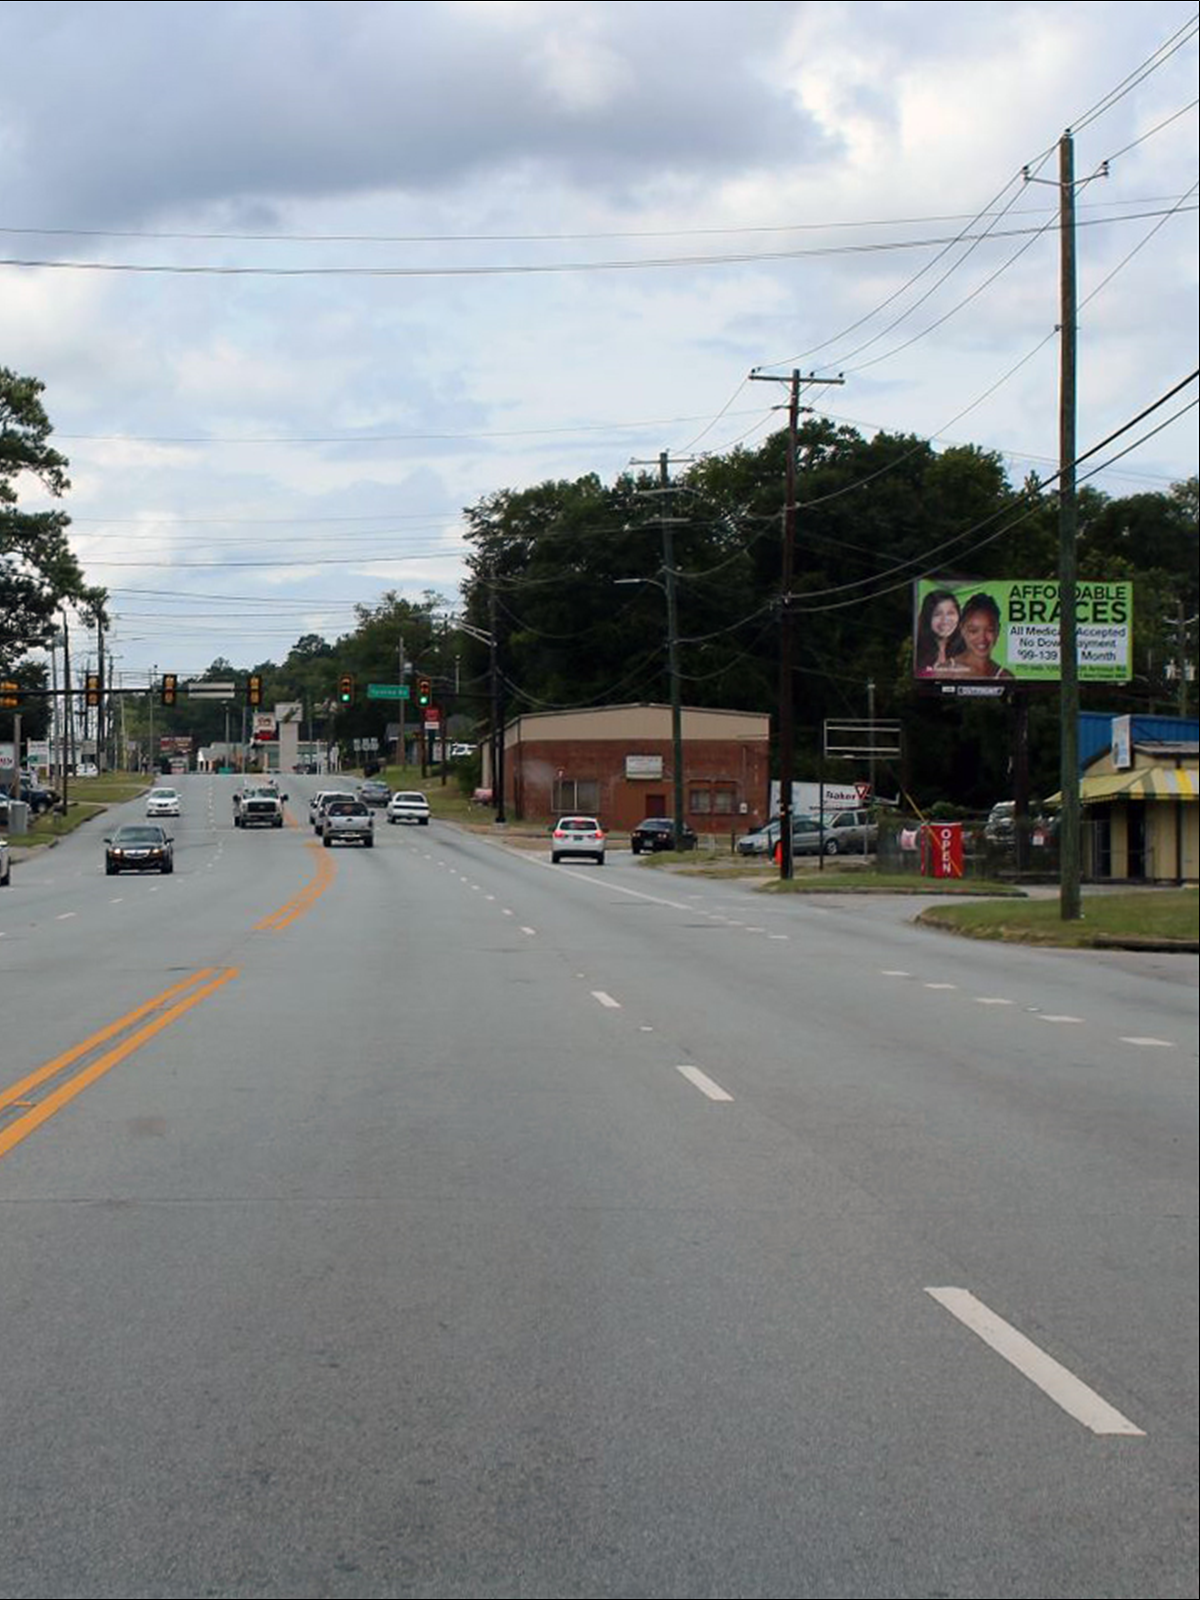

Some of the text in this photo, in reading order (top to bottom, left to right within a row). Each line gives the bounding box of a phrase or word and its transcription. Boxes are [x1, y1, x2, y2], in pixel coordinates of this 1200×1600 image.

[1009, 585, 1127, 600] AFFOABLE
[1037, 638, 1061, 648] Dow
[1075, 640, 1117, 650] ayment
[941, 828, 952, 874] OPEN
